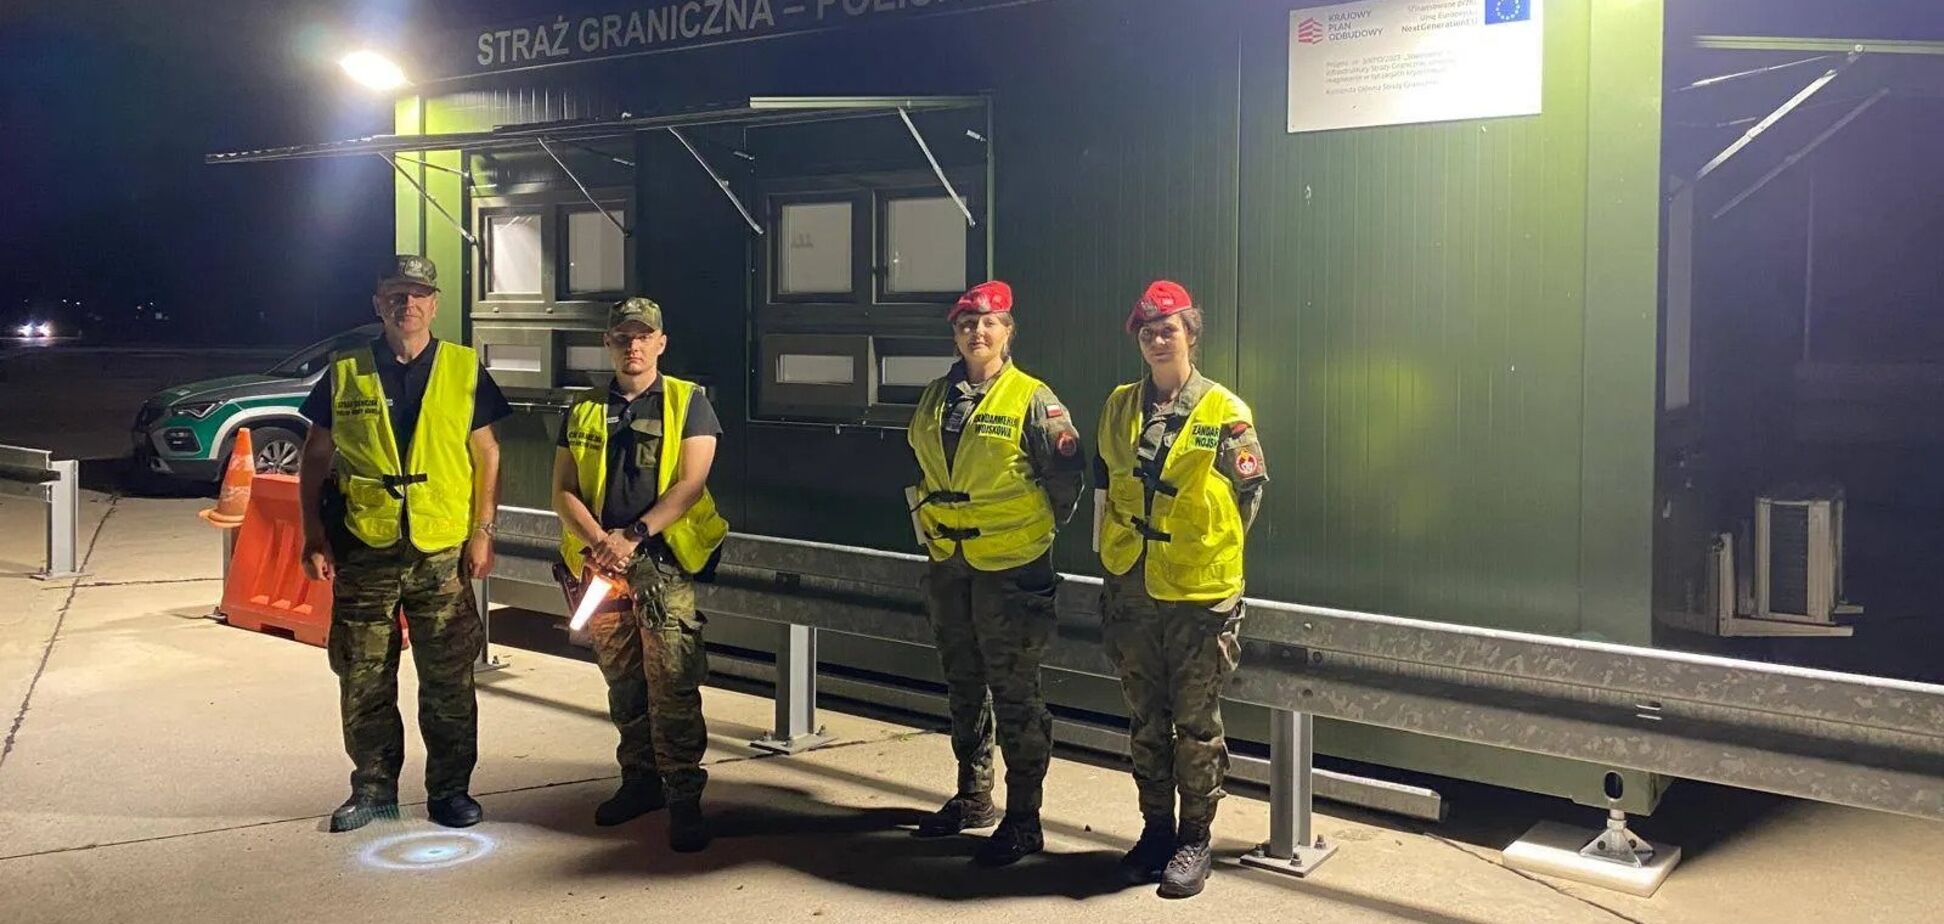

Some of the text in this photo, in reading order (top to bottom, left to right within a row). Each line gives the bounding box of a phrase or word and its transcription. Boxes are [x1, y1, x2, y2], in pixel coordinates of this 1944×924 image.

[1328, 10, 1372, 21] KRAJOWY
[1328, 22, 1352, 31] PLAN
[477, 15, 570, 66] STRAŻ
[578, 0, 775, 52] GRANICZNA
[1328, 28, 1384, 41] ODBUDOWY
